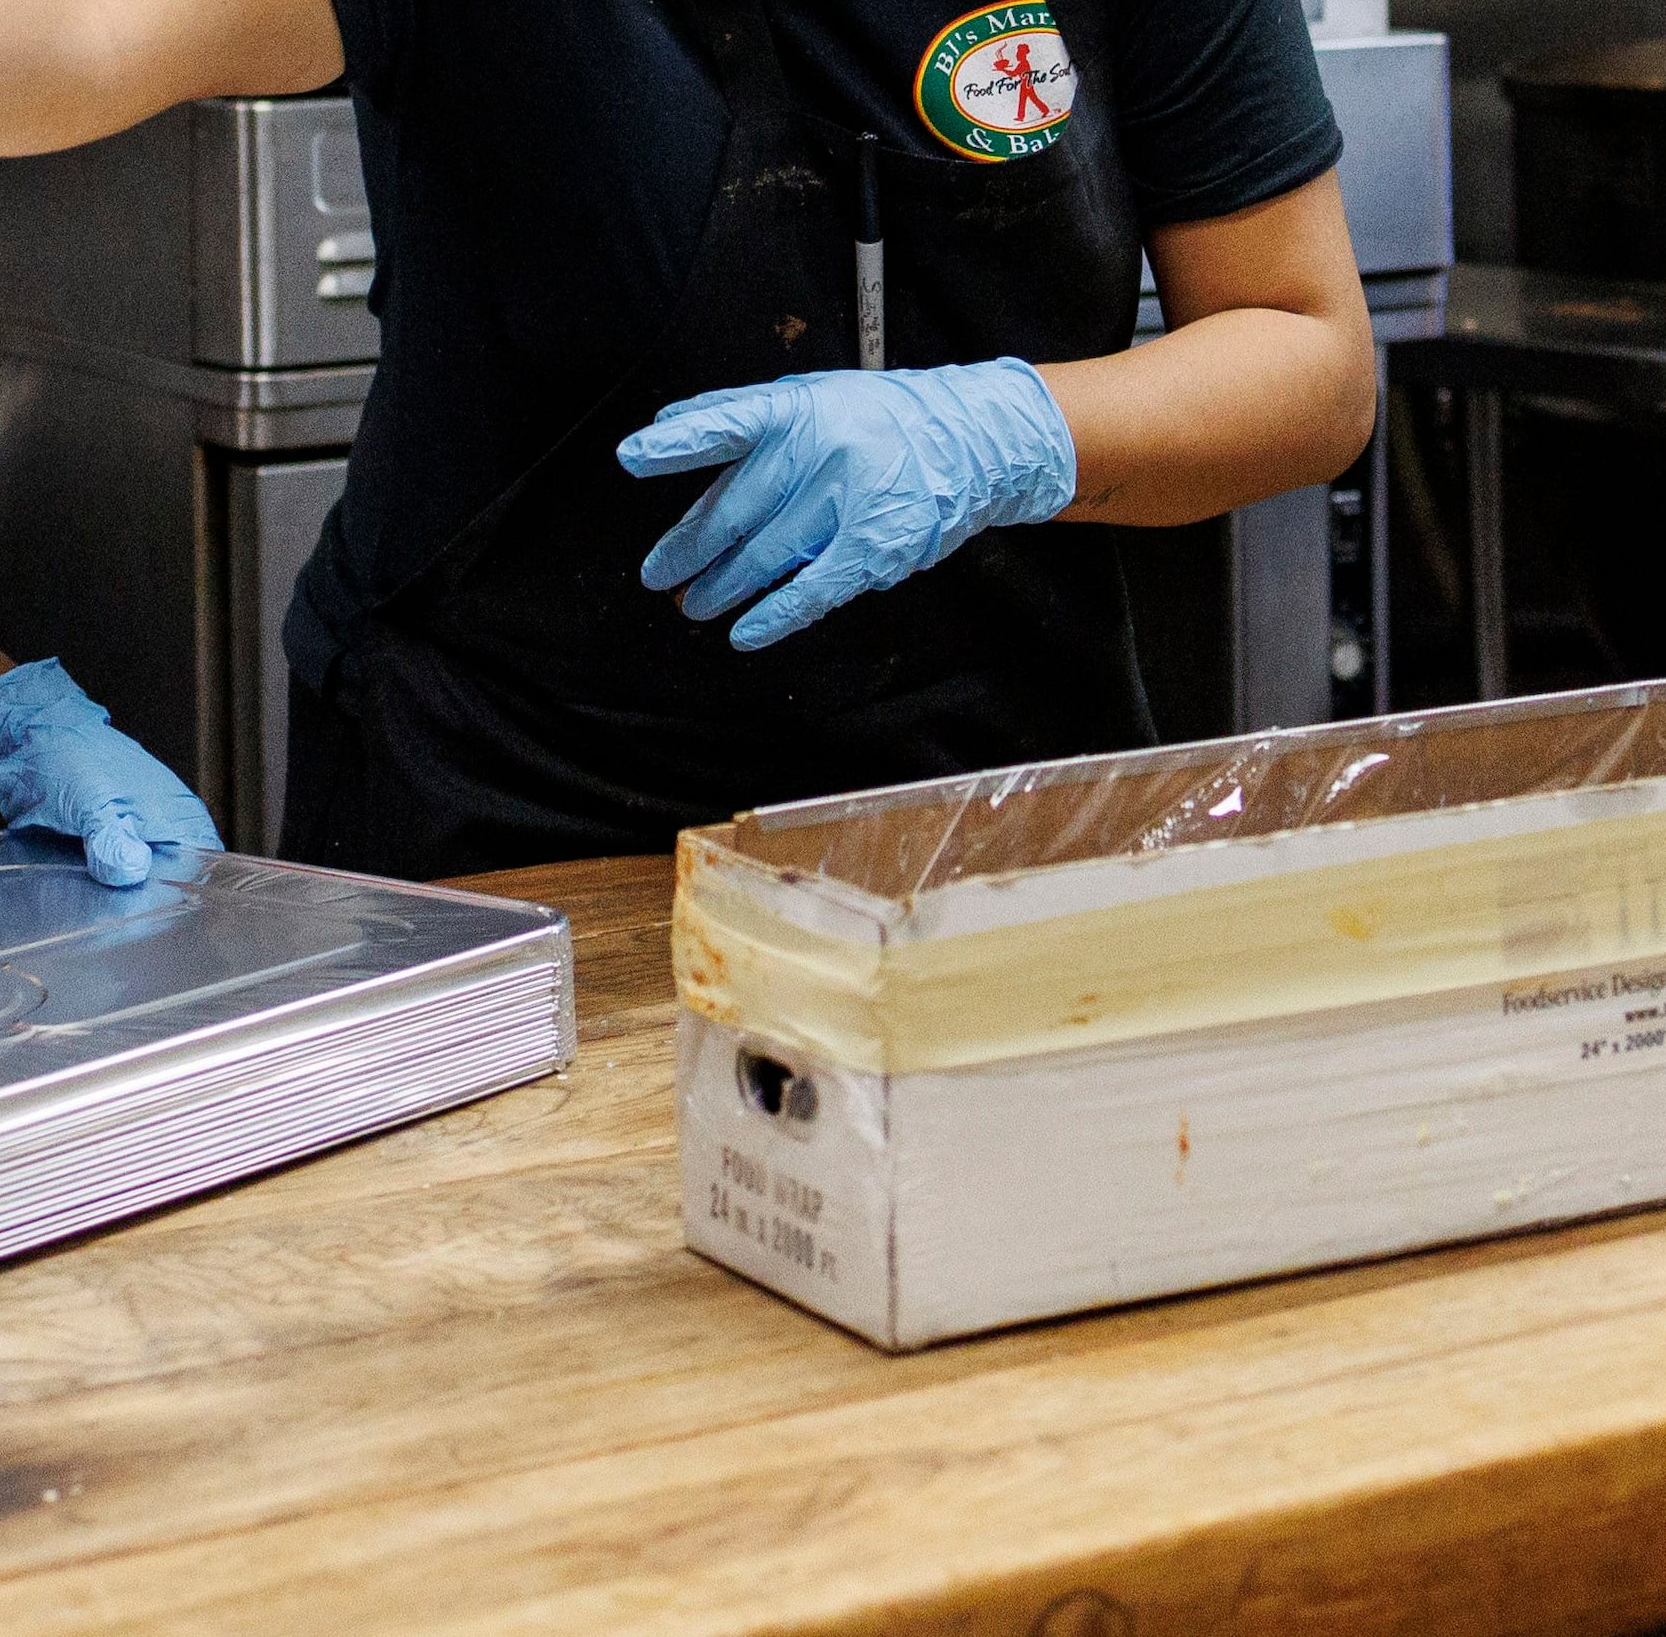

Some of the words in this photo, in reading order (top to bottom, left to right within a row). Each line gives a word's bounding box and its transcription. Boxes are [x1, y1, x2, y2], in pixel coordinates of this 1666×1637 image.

[934, 30, 978, 76] BJ's
[986, 8, 1057, 35] Mar
[964, 83, 994, 100] Food
[996, 77, 1021, 95] For
[1022, 70, 1048, 87] The
[965, 128, 995, 153] &
[1502, 981, 1608, 1016] Foodservice
